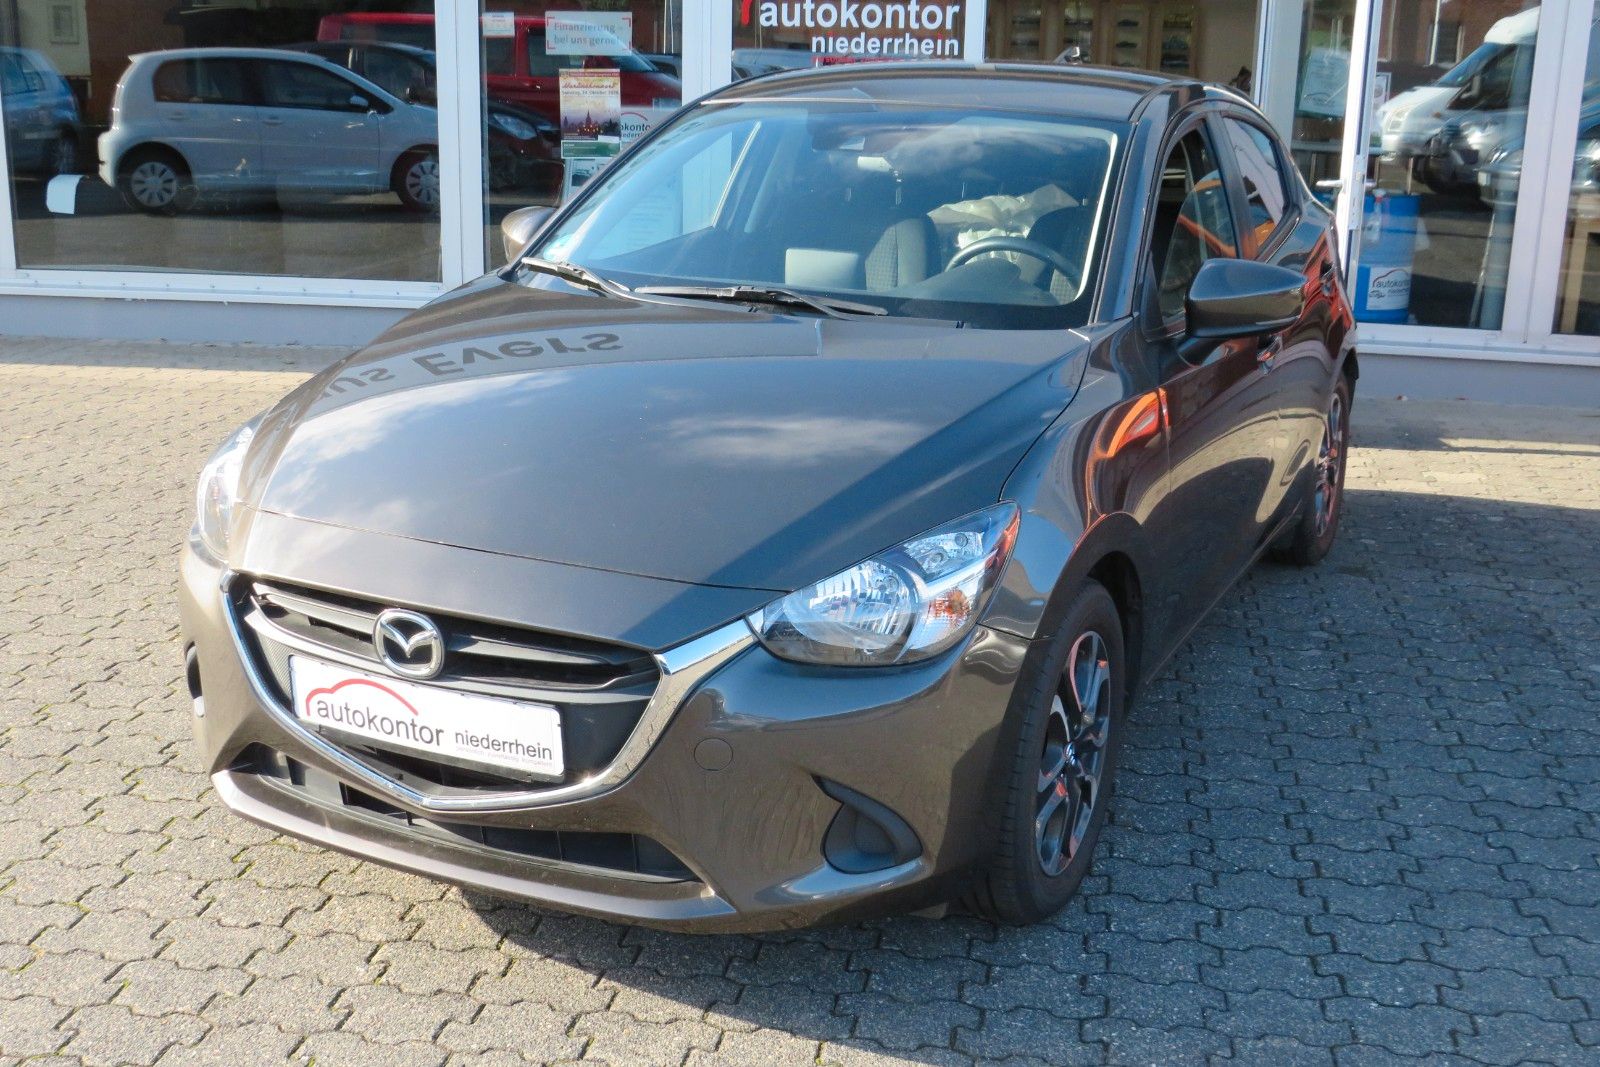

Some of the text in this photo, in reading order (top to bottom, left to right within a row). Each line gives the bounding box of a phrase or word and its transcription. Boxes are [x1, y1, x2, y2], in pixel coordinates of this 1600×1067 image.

[553, 22, 616, 33] Finanzierung
[759, 0, 959, 29] autokontor
[811, 32, 959, 55] niederrhein
[316, 699, 444, 746] autokontor
[455, 730, 553, 760] niederrhein
